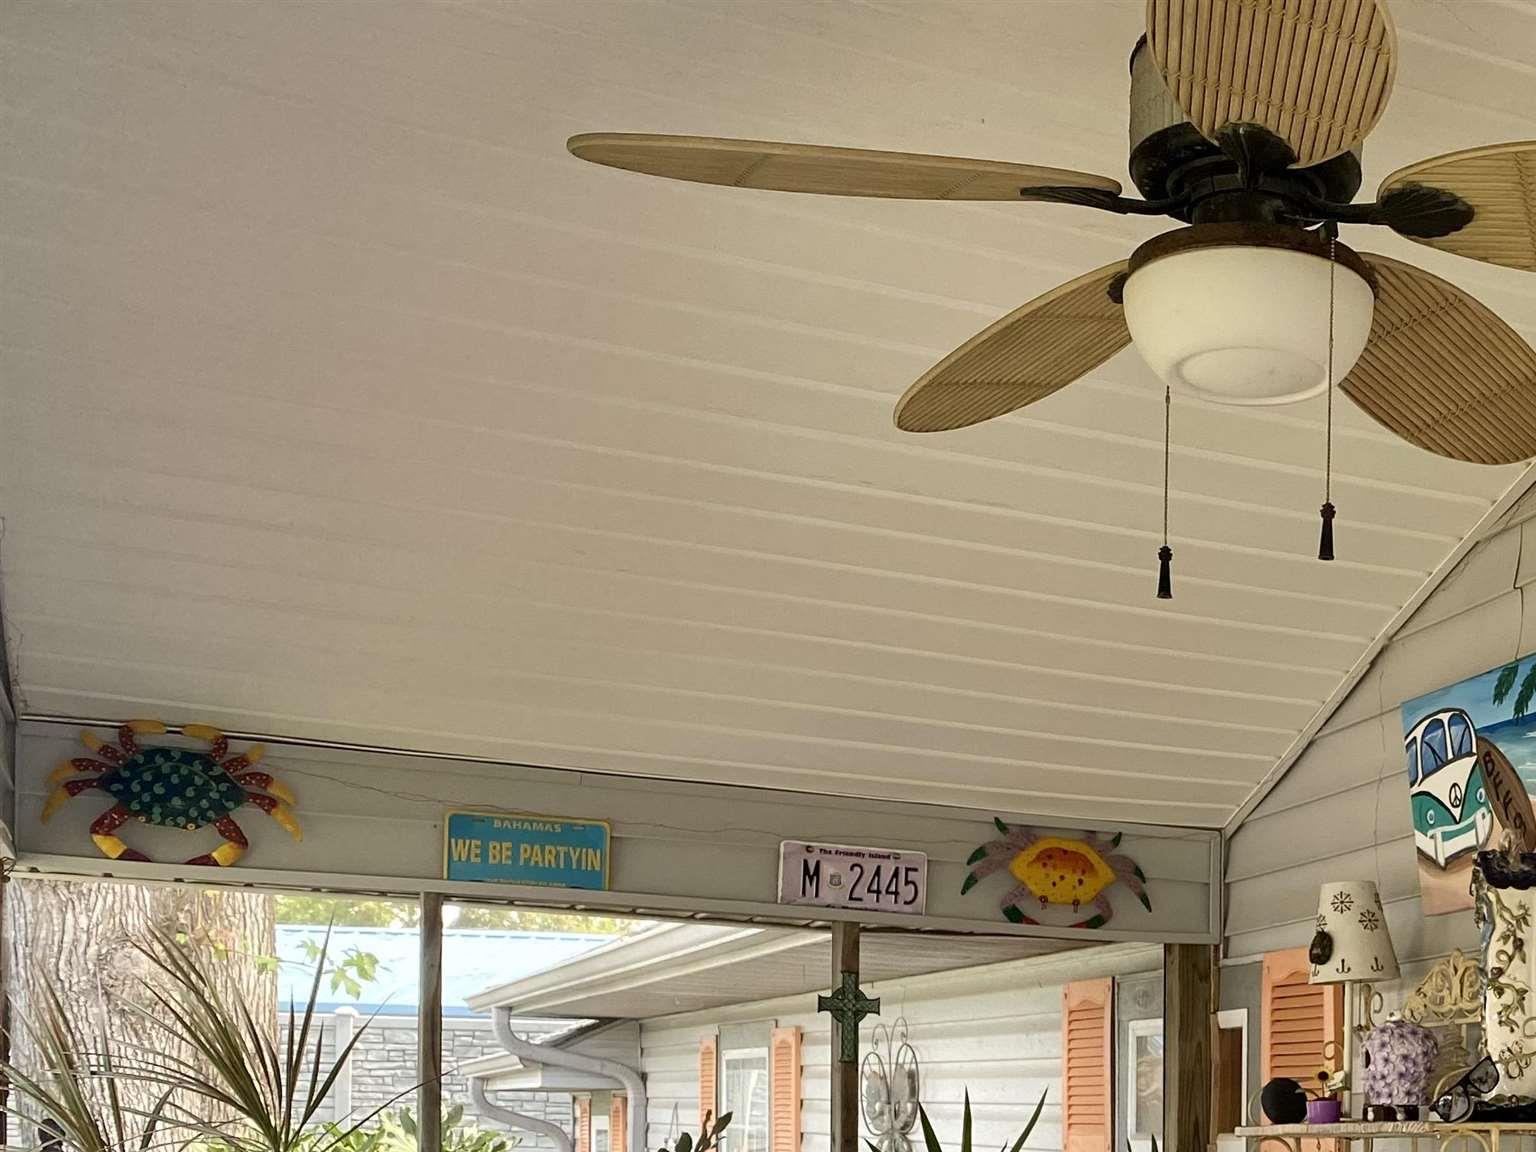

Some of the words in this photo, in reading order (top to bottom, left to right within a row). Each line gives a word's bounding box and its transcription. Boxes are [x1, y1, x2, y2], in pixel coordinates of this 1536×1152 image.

[493, 818, 563, 833] BAHAMAS
[451, 838, 481, 864] WE
[489, 841, 512, 865] BE
[520, 843, 602, 871] PARTYIN
[802, 858, 820, 898] M
[848, 863, 919, 906] 2445
